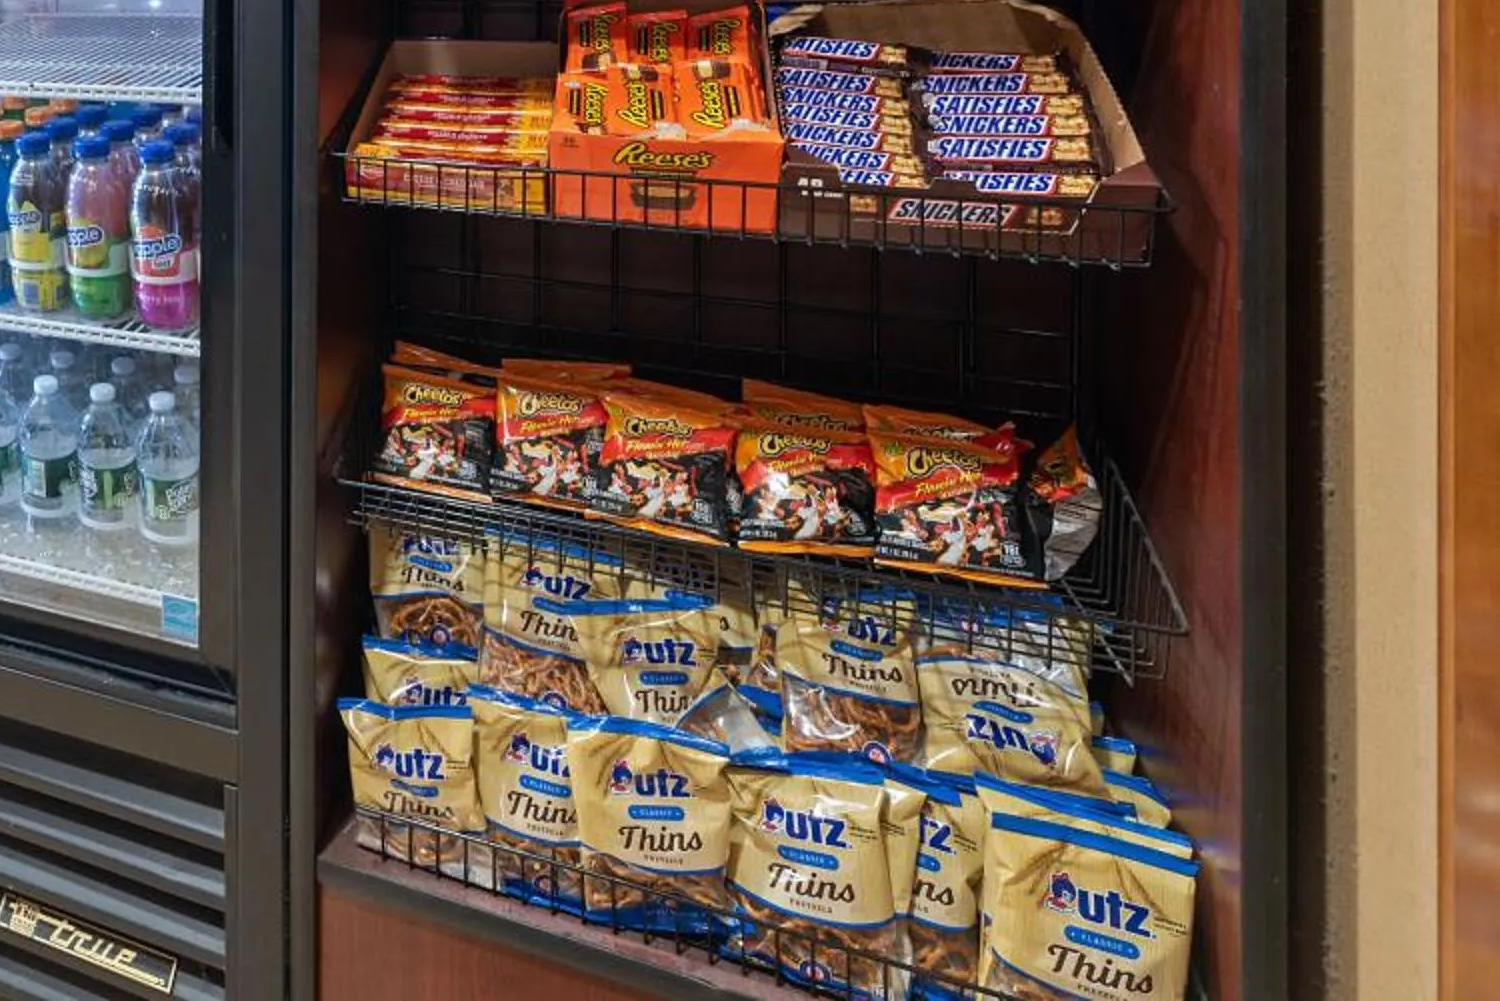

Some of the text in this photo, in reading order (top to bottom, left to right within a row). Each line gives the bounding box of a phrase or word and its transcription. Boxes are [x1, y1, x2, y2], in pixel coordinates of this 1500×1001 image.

[930, 53, 1017, 71] NICKERS
[775, 68, 872, 92] SATISFIES
[922, 74, 1023, 94] SNICKERS
[782, 86, 878, 113] SNICKERS
[931, 96, 1040, 115] SATISFIES
[938, 115, 1045, 135] SNICKERS
[612, 141, 716, 169] Reese's
[938, 138, 1048, 160] SATISFIES
[404, 384, 463, 407] Cheetos
[518, 393, 583, 416] Cheetos
[625, 417, 692, 438] Cheetos
[907, 448, 982, 476] Cheetos
[400, 566, 466, 593] Thins
[543, 573, 593, 600] utz
[643, 638, 697, 667] utz
[821, 652, 903, 684] Thins
[965, 713, 1031, 753] utz
[394, 748, 446, 780] utz
[634, 769, 689, 798] utz
[384, 790, 454, 819] Thins
[618, 825, 703, 854] Thins
[785, 809, 847, 849] utz
[1077, 887, 1151, 938] utz
[1047, 944, 1154, 994] Thins
